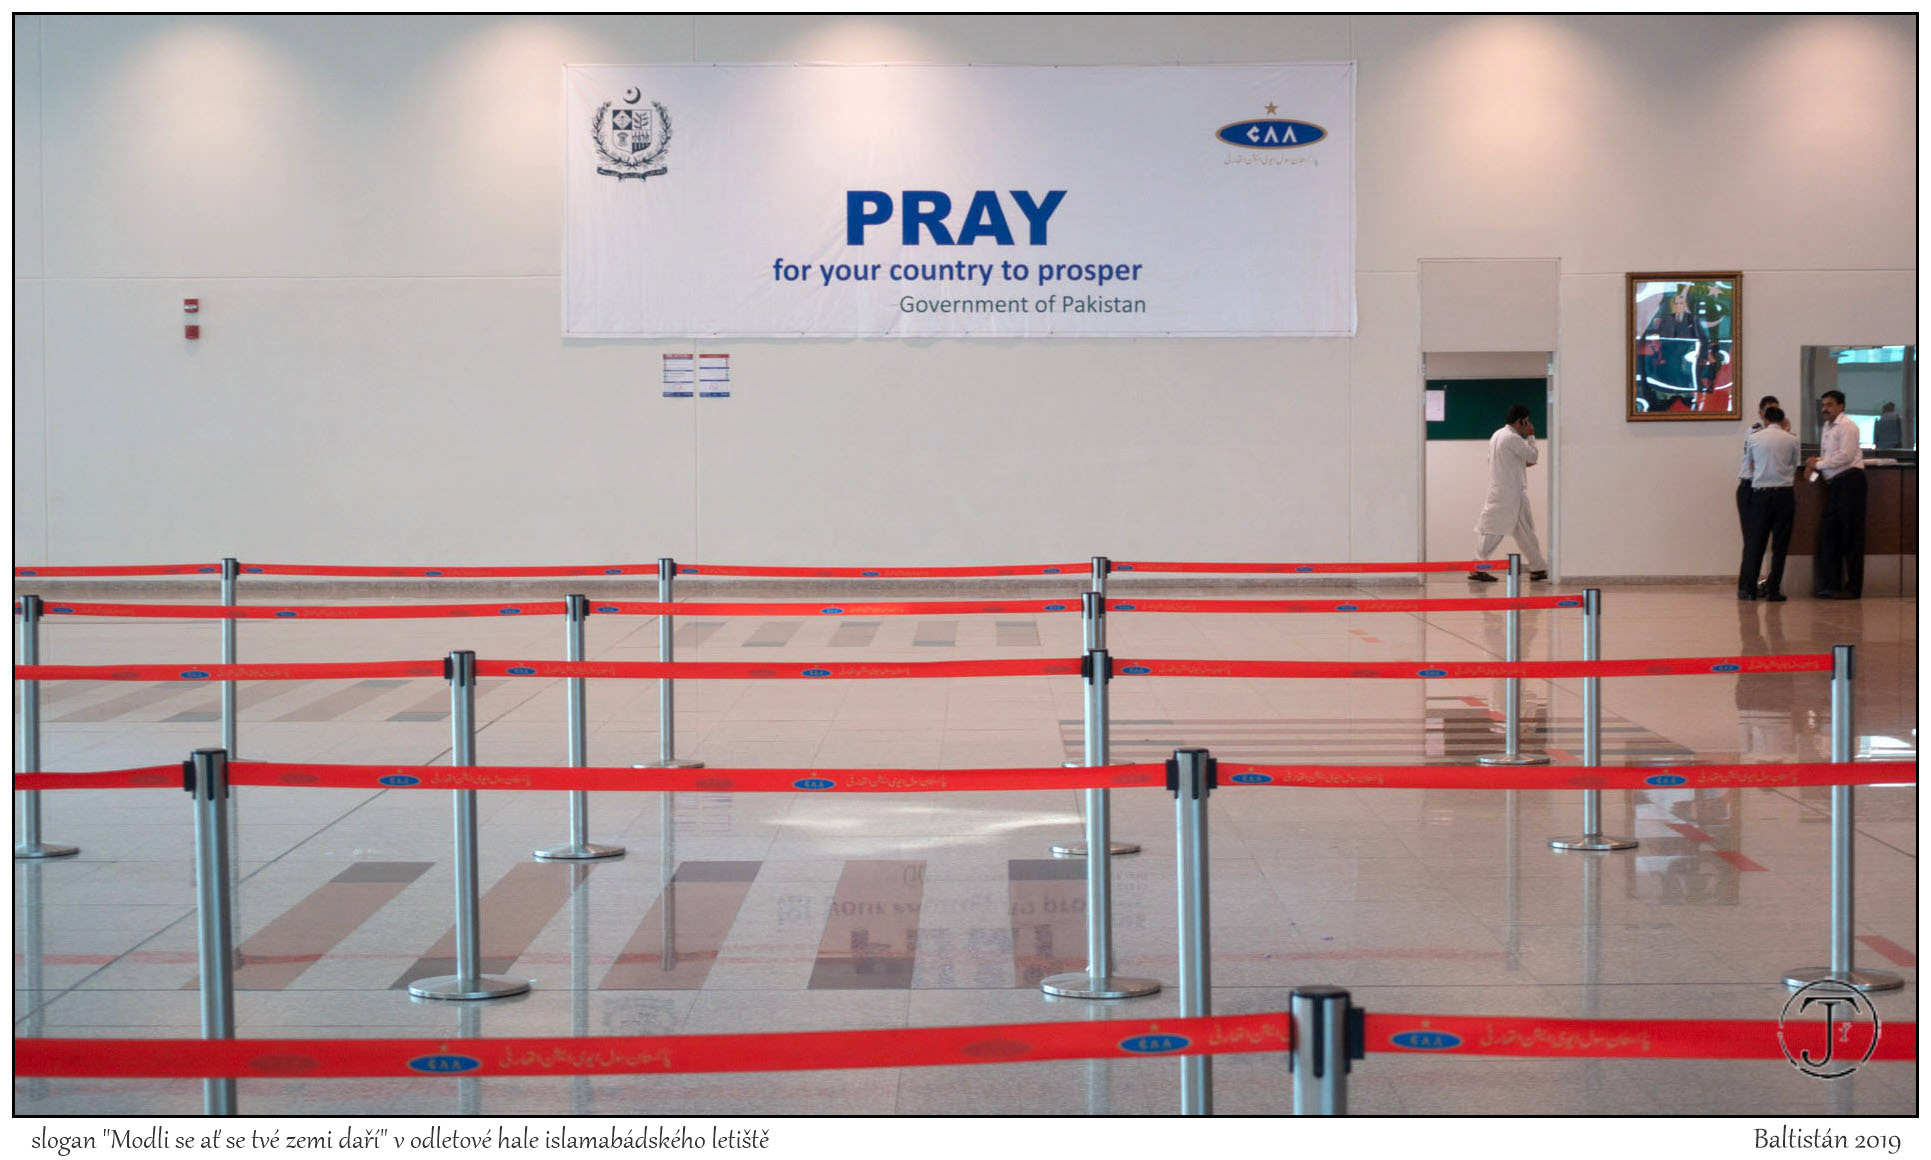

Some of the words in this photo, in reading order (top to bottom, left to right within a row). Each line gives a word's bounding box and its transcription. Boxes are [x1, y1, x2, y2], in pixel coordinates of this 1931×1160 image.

[846, 190, 1068, 246] PRAY
[773, 257, 812, 281] for
[820, 263, 882, 287] your
[889, 260, 994, 287] country
[1001, 260, 1030, 281] to
[1039, 263, 1143, 287] prosper
[899, 295, 1029, 313] Government
[1035, 294, 1057, 313] of
[1062, 294, 1146, 313] Pakistan
